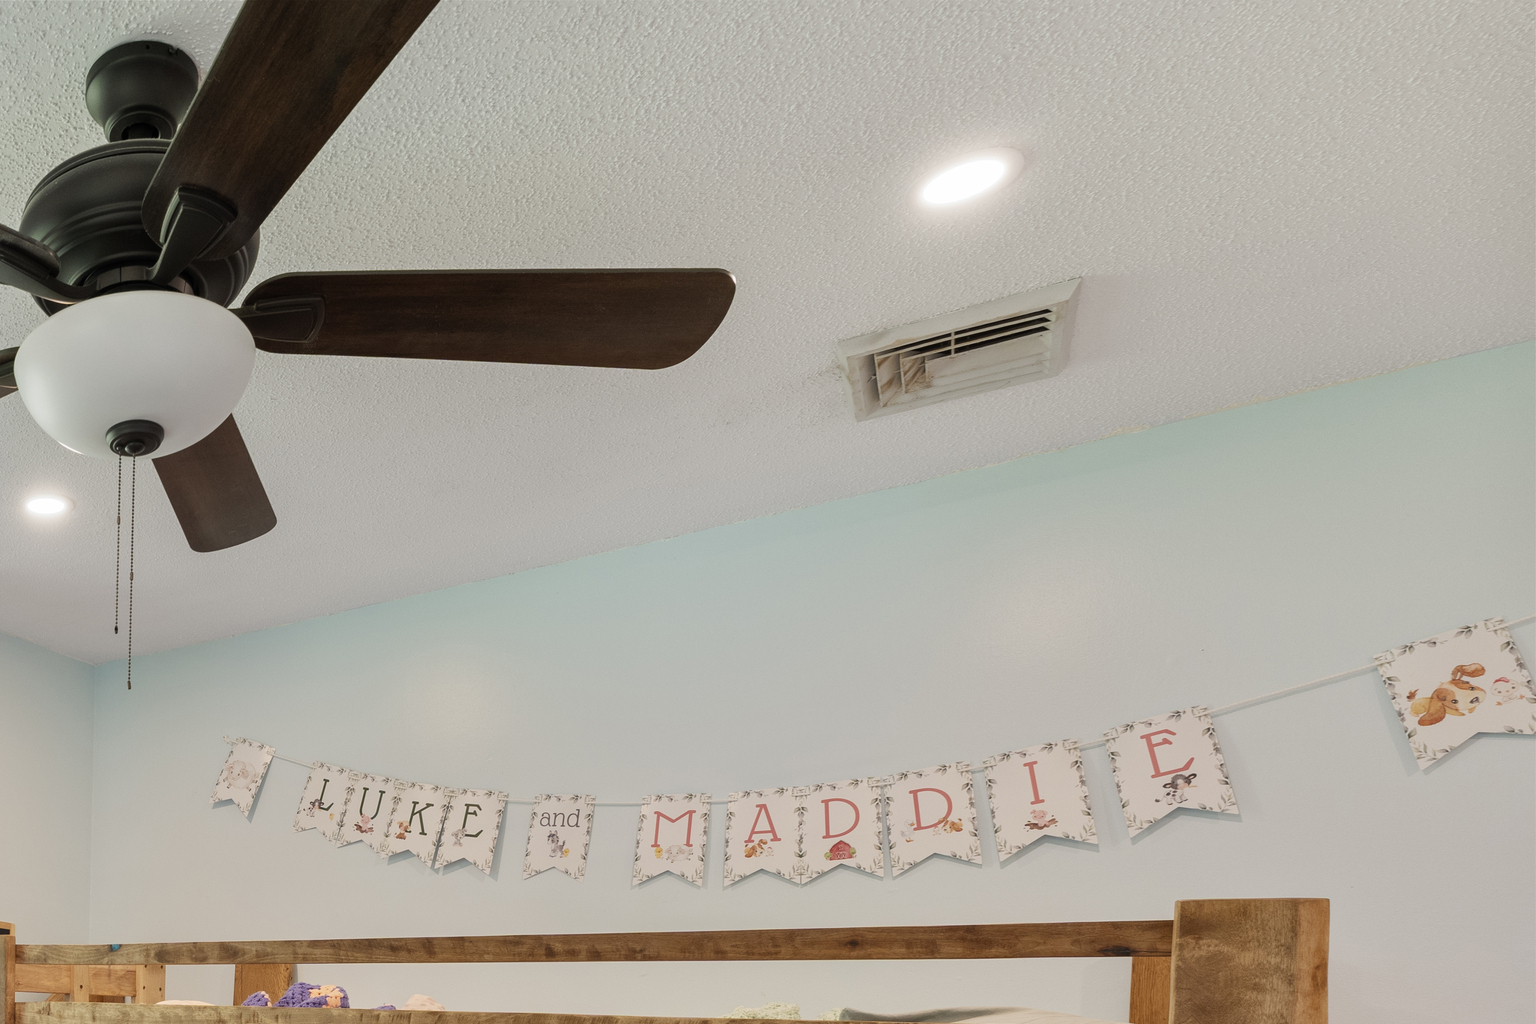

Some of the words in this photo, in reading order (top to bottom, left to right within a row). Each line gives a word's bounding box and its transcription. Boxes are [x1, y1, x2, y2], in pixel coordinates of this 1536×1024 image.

[317, 778, 484, 838] LUKE
[539, 809, 581, 828] and
[650, 728, 1195, 848] MADDIE
